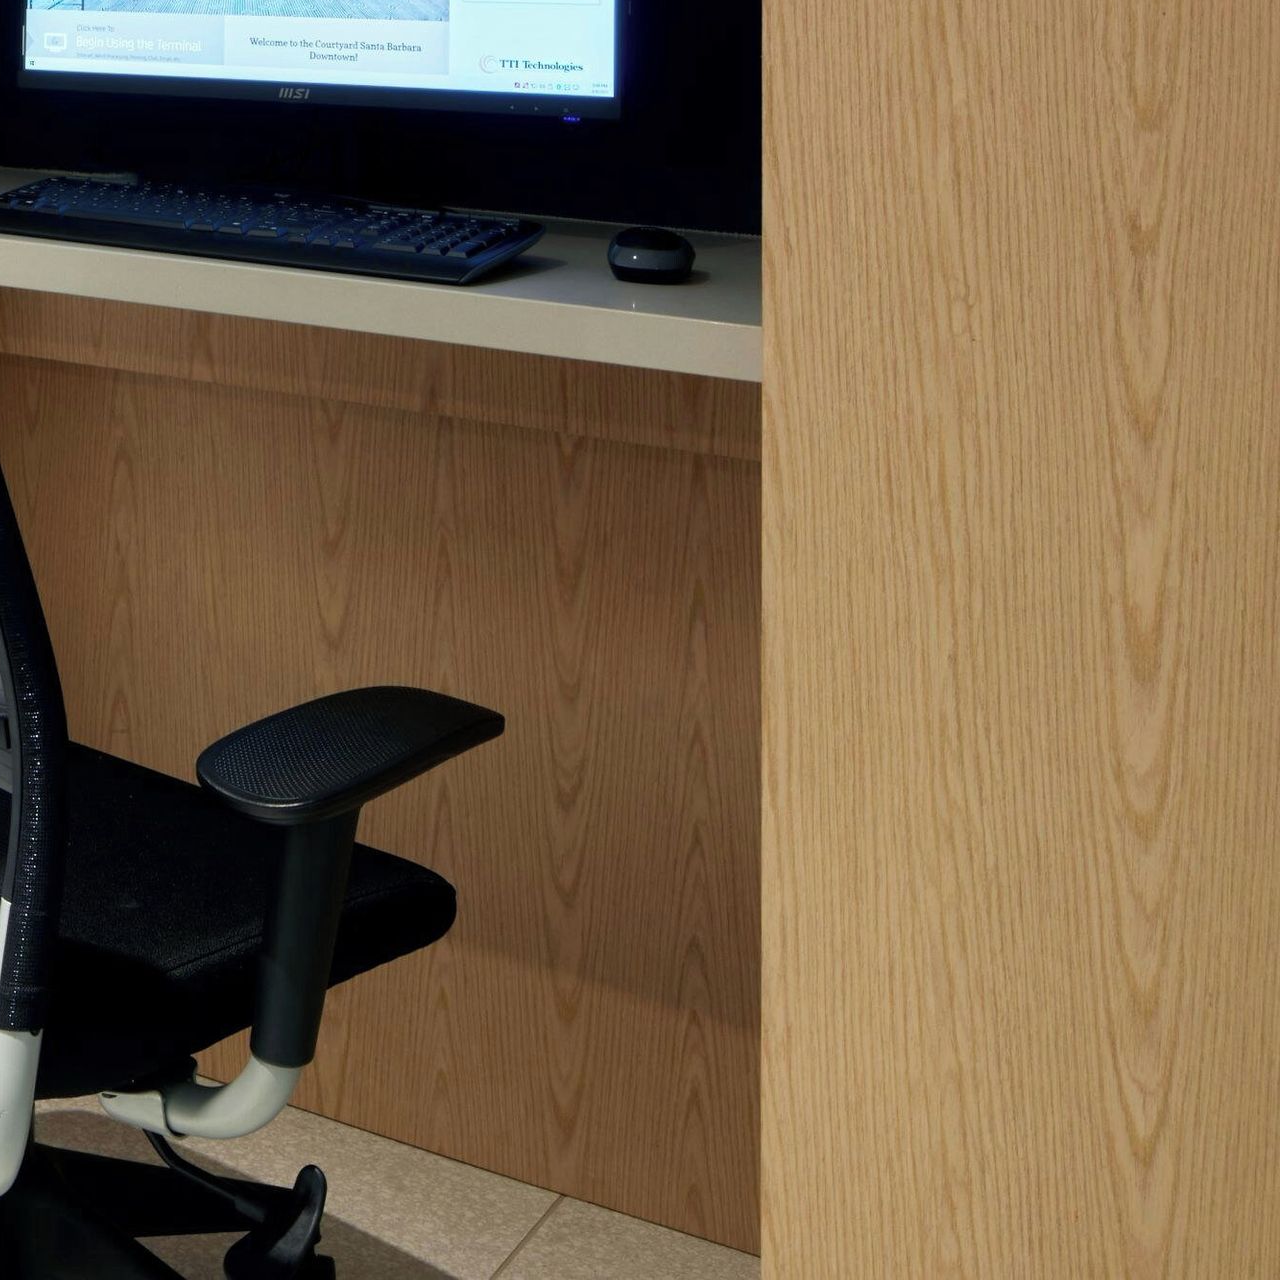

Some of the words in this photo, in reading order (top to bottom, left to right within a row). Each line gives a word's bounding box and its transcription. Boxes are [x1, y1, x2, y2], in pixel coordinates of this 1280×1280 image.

[76, 35, 104, 50] Begin
[106, 37, 135, 52] Using
[157, 39, 202, 53] Terminal
[249, 37, 288, 47] Welcome
[289, 40, 298, 48] to
[300, 40, 313, 49] the
[314, 40, 358, 51] Courtyard
[360, 41, 385, 51] Santa
[387, 42, 422, 52] Barbara
[309, 51, 358, 62] Downtown!
[499, 59, 519, 69] TTI
[522, 60, 583, 72] Technologies
